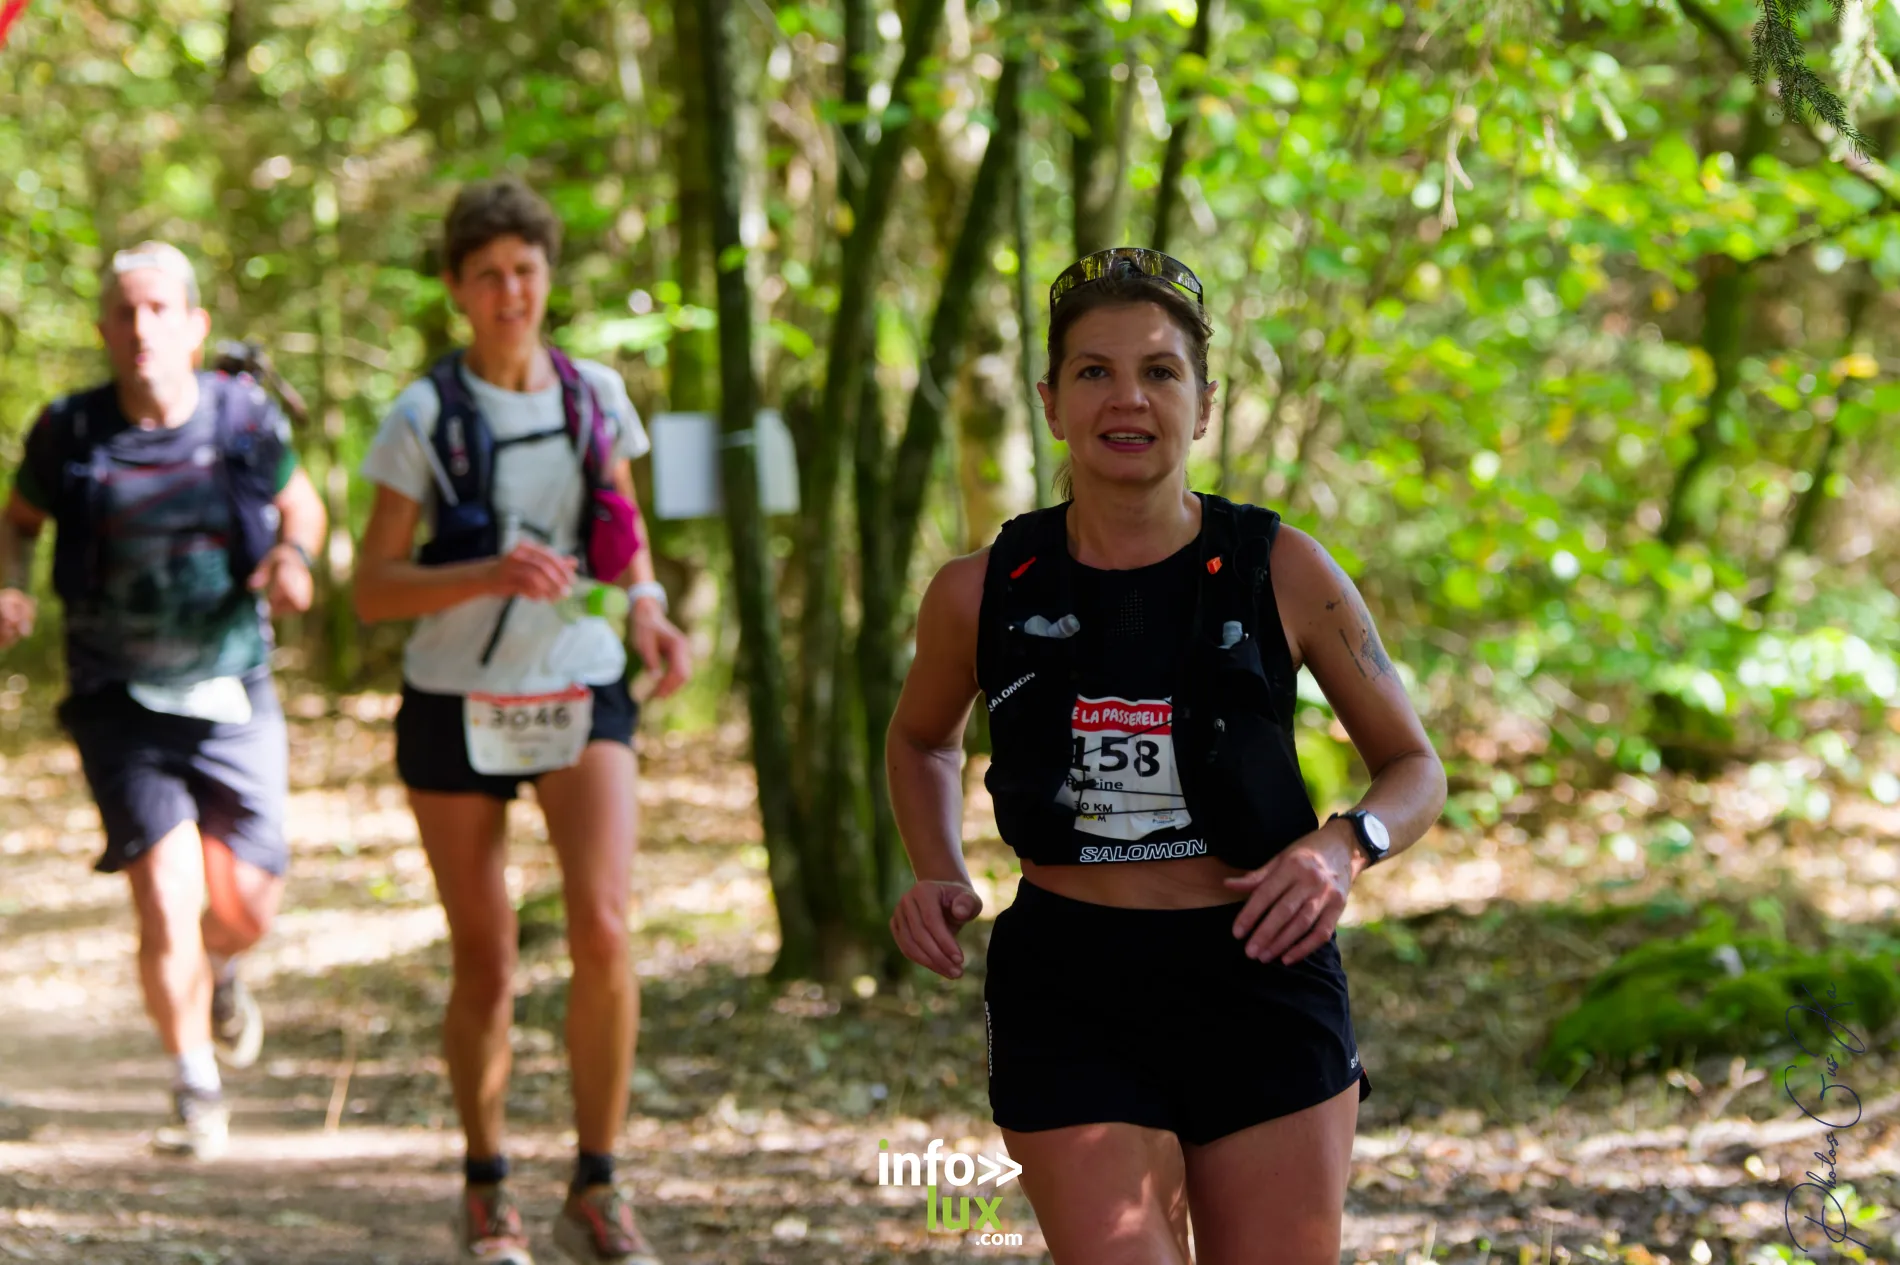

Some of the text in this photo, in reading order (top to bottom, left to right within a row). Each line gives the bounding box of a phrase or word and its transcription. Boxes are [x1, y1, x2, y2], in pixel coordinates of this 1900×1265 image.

[490, 703, 571, 731] 3046
[1081, 709, 1100, 724] LA
[1093, 803, 1113, 813] KM
[1080, 838, 1208, 863] SALOMON
